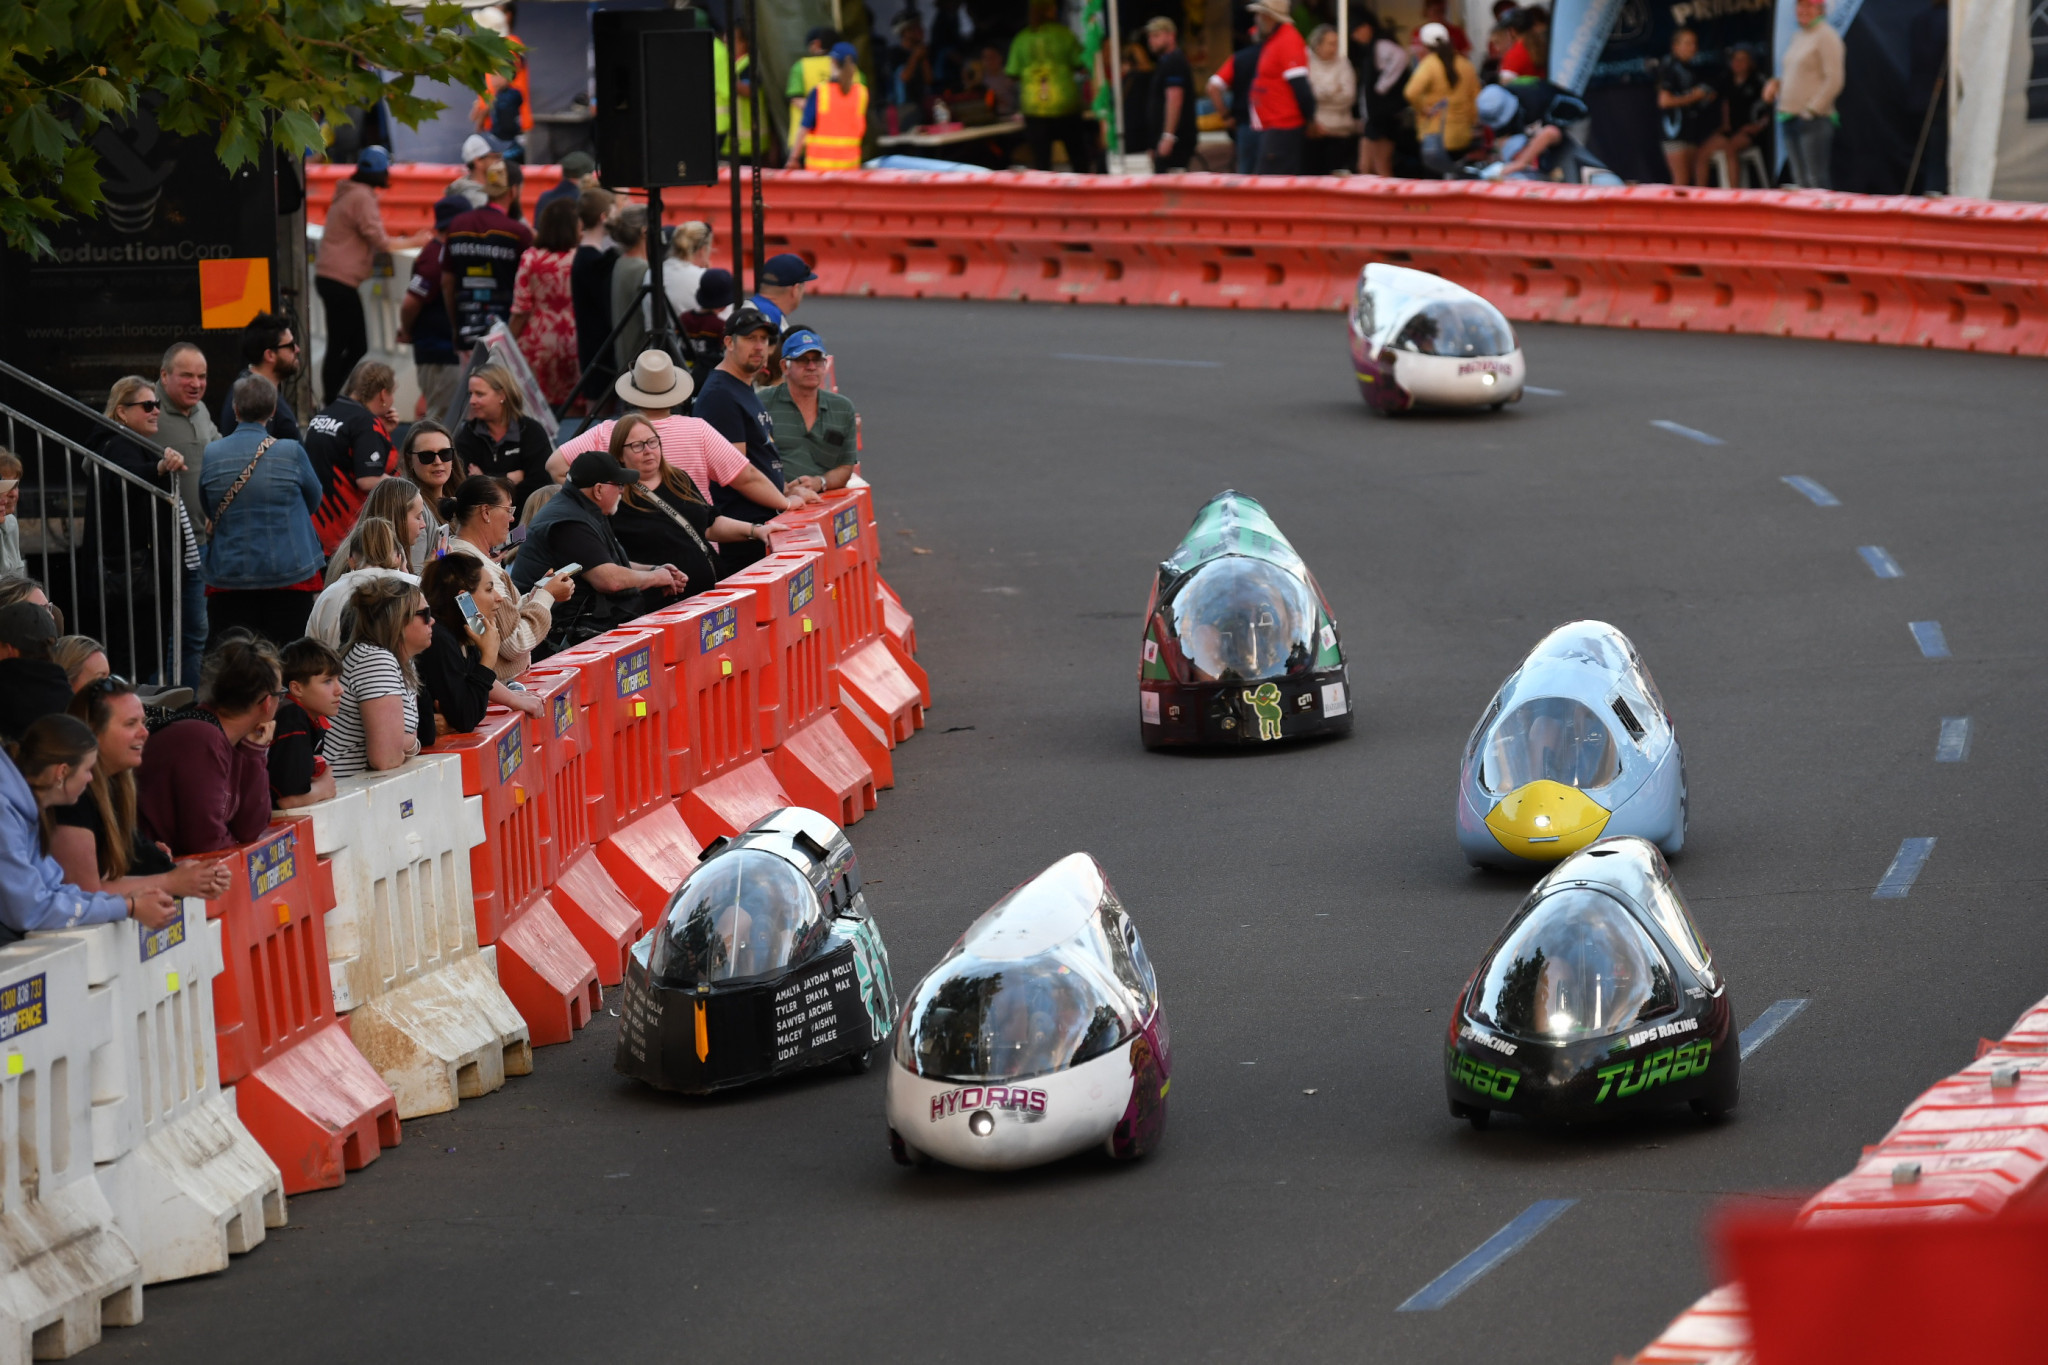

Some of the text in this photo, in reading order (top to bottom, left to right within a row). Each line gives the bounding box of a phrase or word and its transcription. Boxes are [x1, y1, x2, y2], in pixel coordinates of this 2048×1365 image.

[775, 961, 853, 1002] AMALYA JAYDAH MOLLY
[775, 978, 851, 1017] TYLER EMAYA MAX
[776, 1000, 833, 1032] SAWYER ARCHIE
[1658, 1017, 1698, 1038] RACING
[777, 1028, 803, 1046] MACEY
[778, 1029, 838, 1061] UDAY ASHLEE
[1474, 1031, 1519, 1056] RACING
[1594, 1037, 1712, 1105] TURBO
[930, 1086, 1048, 1122] HYDRAS
